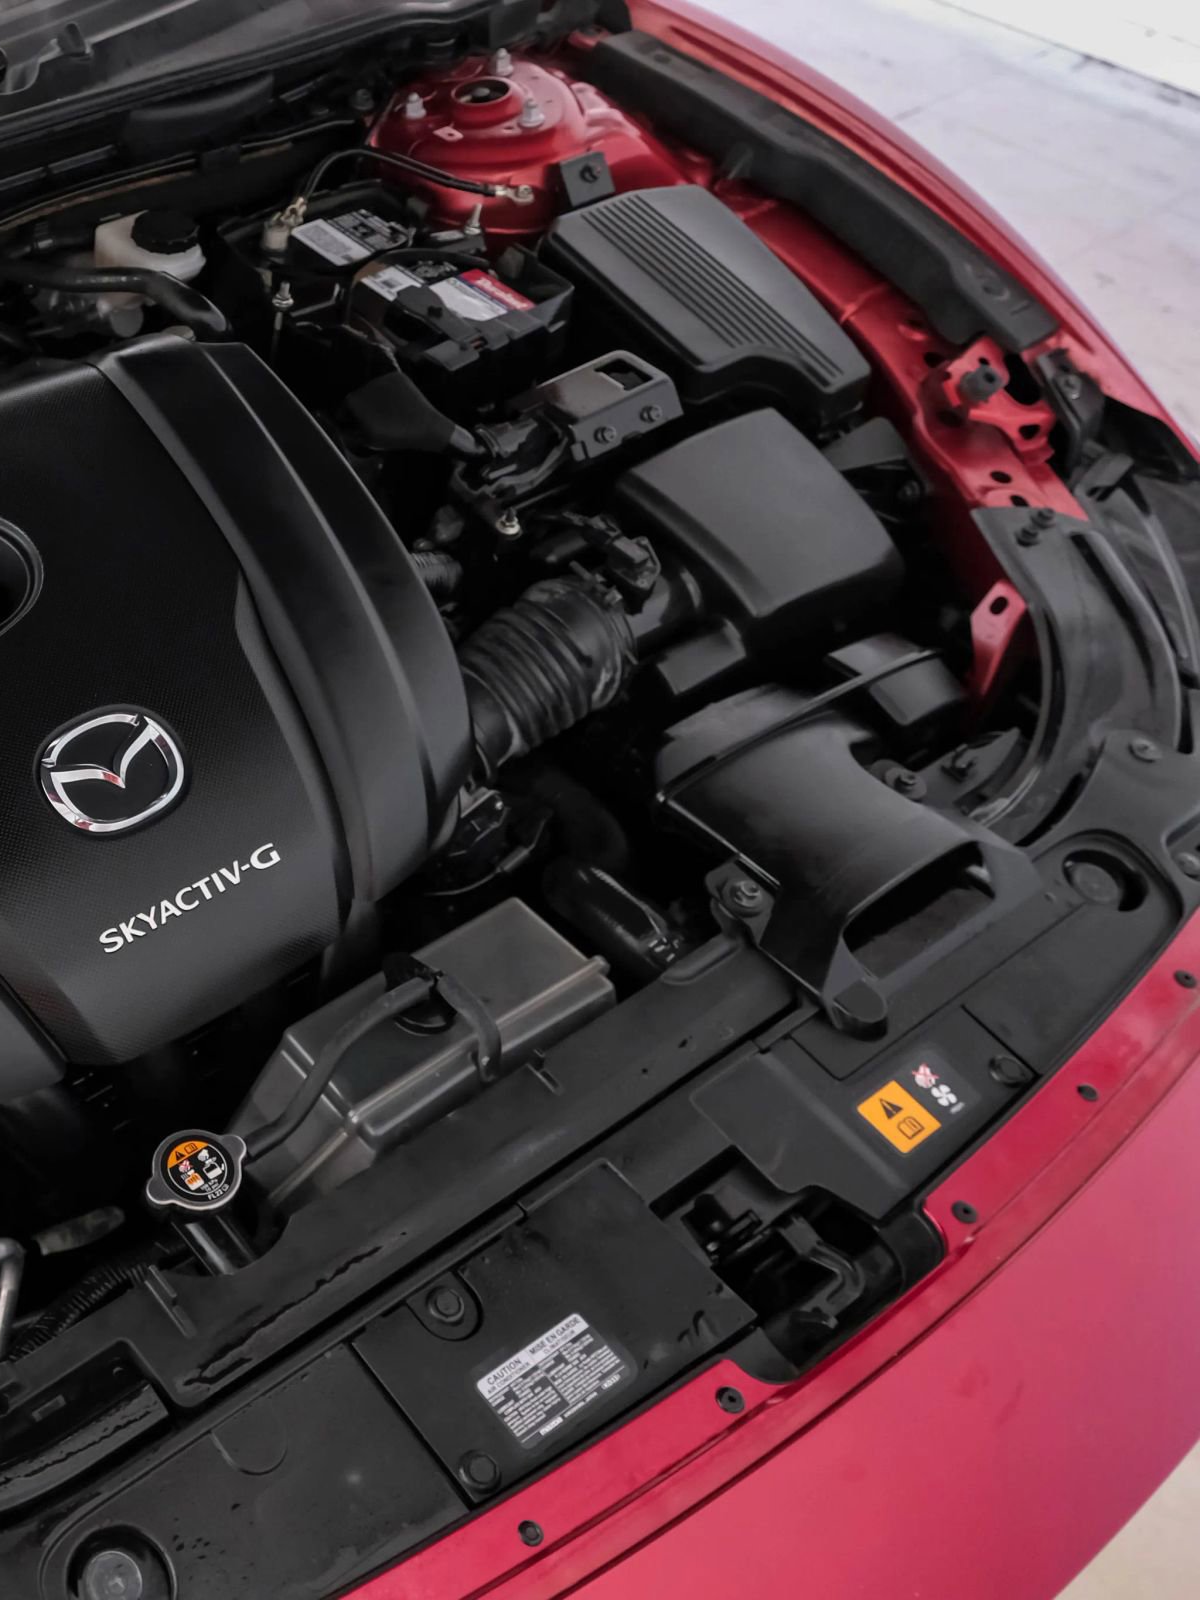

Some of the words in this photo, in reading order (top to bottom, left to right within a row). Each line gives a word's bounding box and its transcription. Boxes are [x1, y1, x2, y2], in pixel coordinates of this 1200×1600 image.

[99, 842, 281, 953] SKYACTIV-G
[528, 1340, 547, 1355] MISE
[545, 1333, 557, 1344] EN
[556, 1316, 580, 1337] GARDE
[487, 1358, 522, 1386] CAUTION
